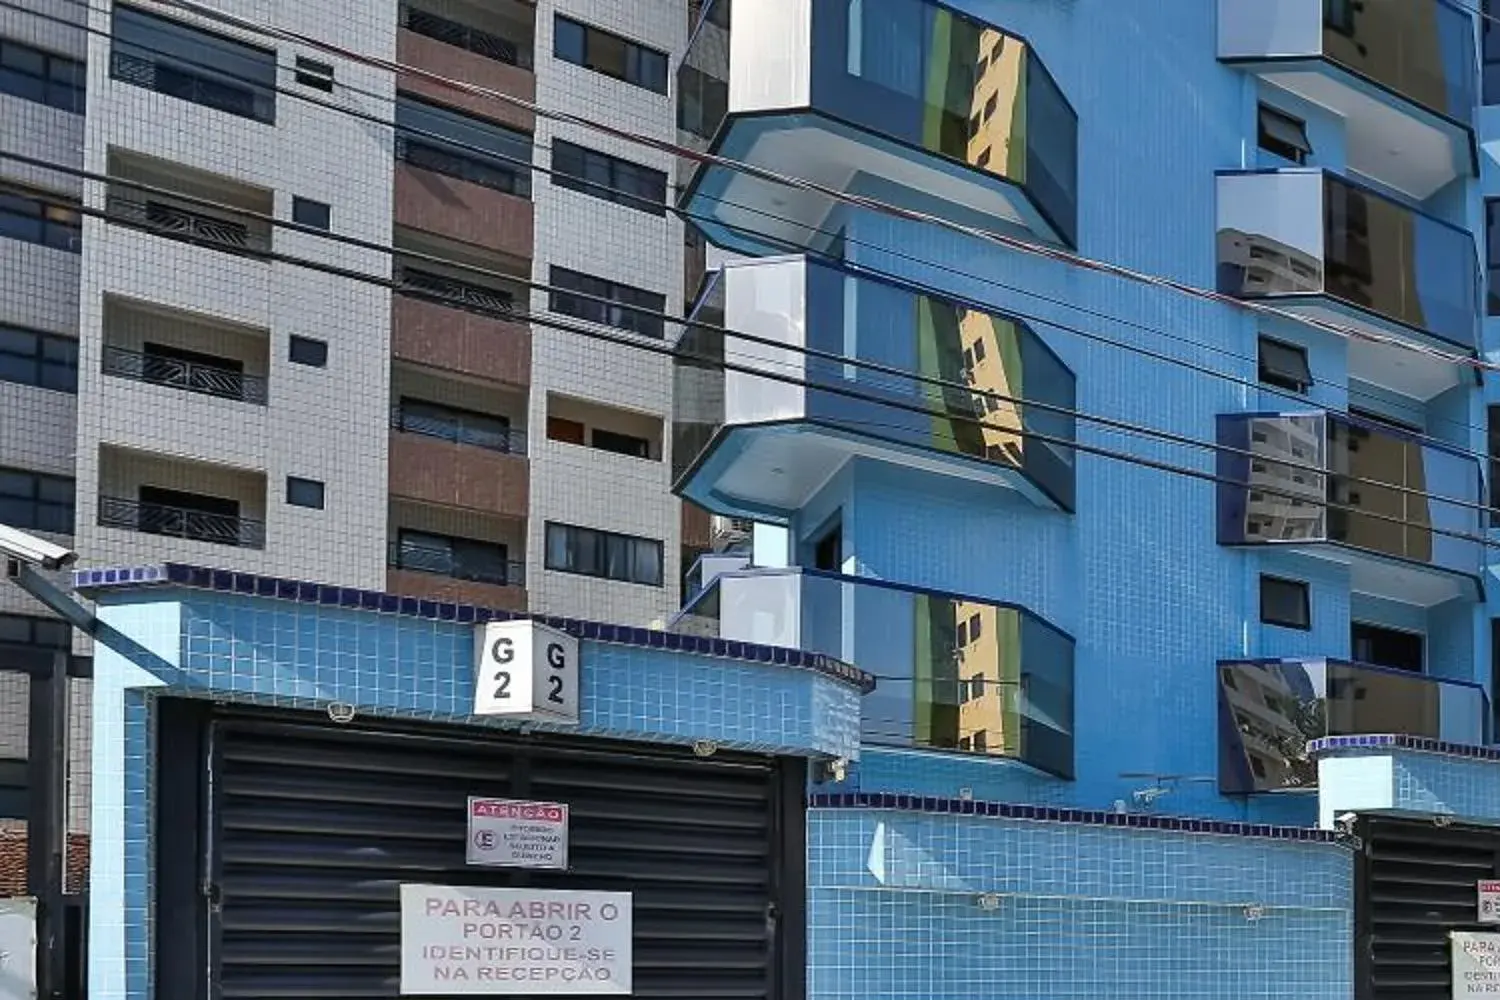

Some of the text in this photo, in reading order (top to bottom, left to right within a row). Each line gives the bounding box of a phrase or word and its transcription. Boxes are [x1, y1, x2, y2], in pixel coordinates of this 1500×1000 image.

[425, 898, 619, 921] PARA ABRIR O
[463, 922, 582, 941] PORTÃO 2
[422, 945, 616, 962] IDENTIFIQUE-SE
[1463, 941, 1495, 953] PARA
[433, 966, 612, 982] NA RECEPÇÃO
